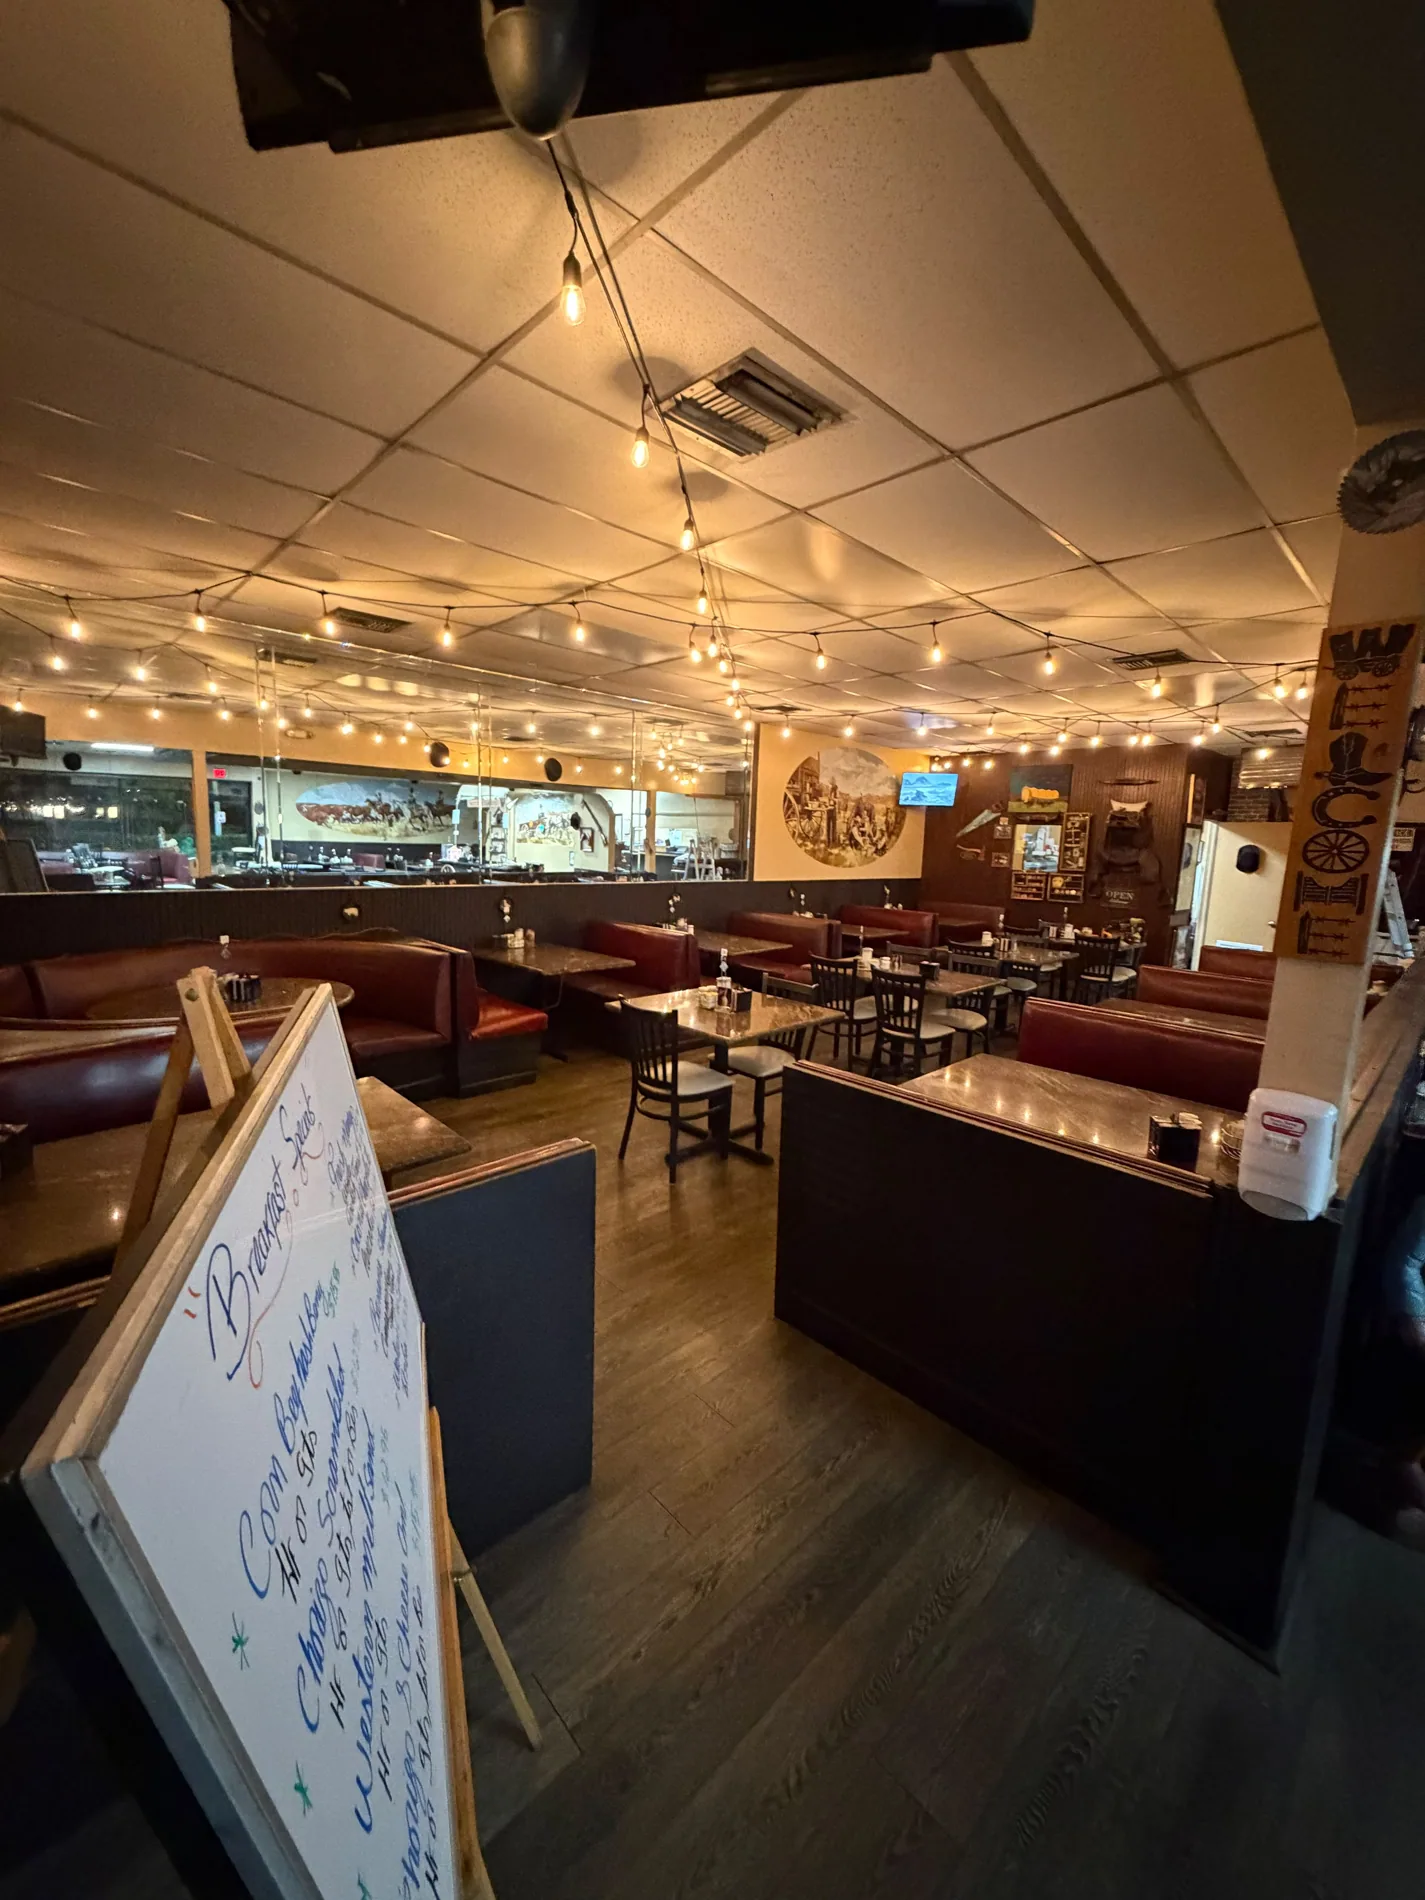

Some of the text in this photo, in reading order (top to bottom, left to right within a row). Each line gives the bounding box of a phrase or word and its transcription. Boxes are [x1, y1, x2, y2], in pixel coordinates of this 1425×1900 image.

[1105, 890, 1134, 900] OPEN
[206, 1154, 287, 1381] Breakfast
[296, 1495, 307, 1544] or
[354, 1599, 375, 1834] Western
[380, 1688, 389, 1726] or
